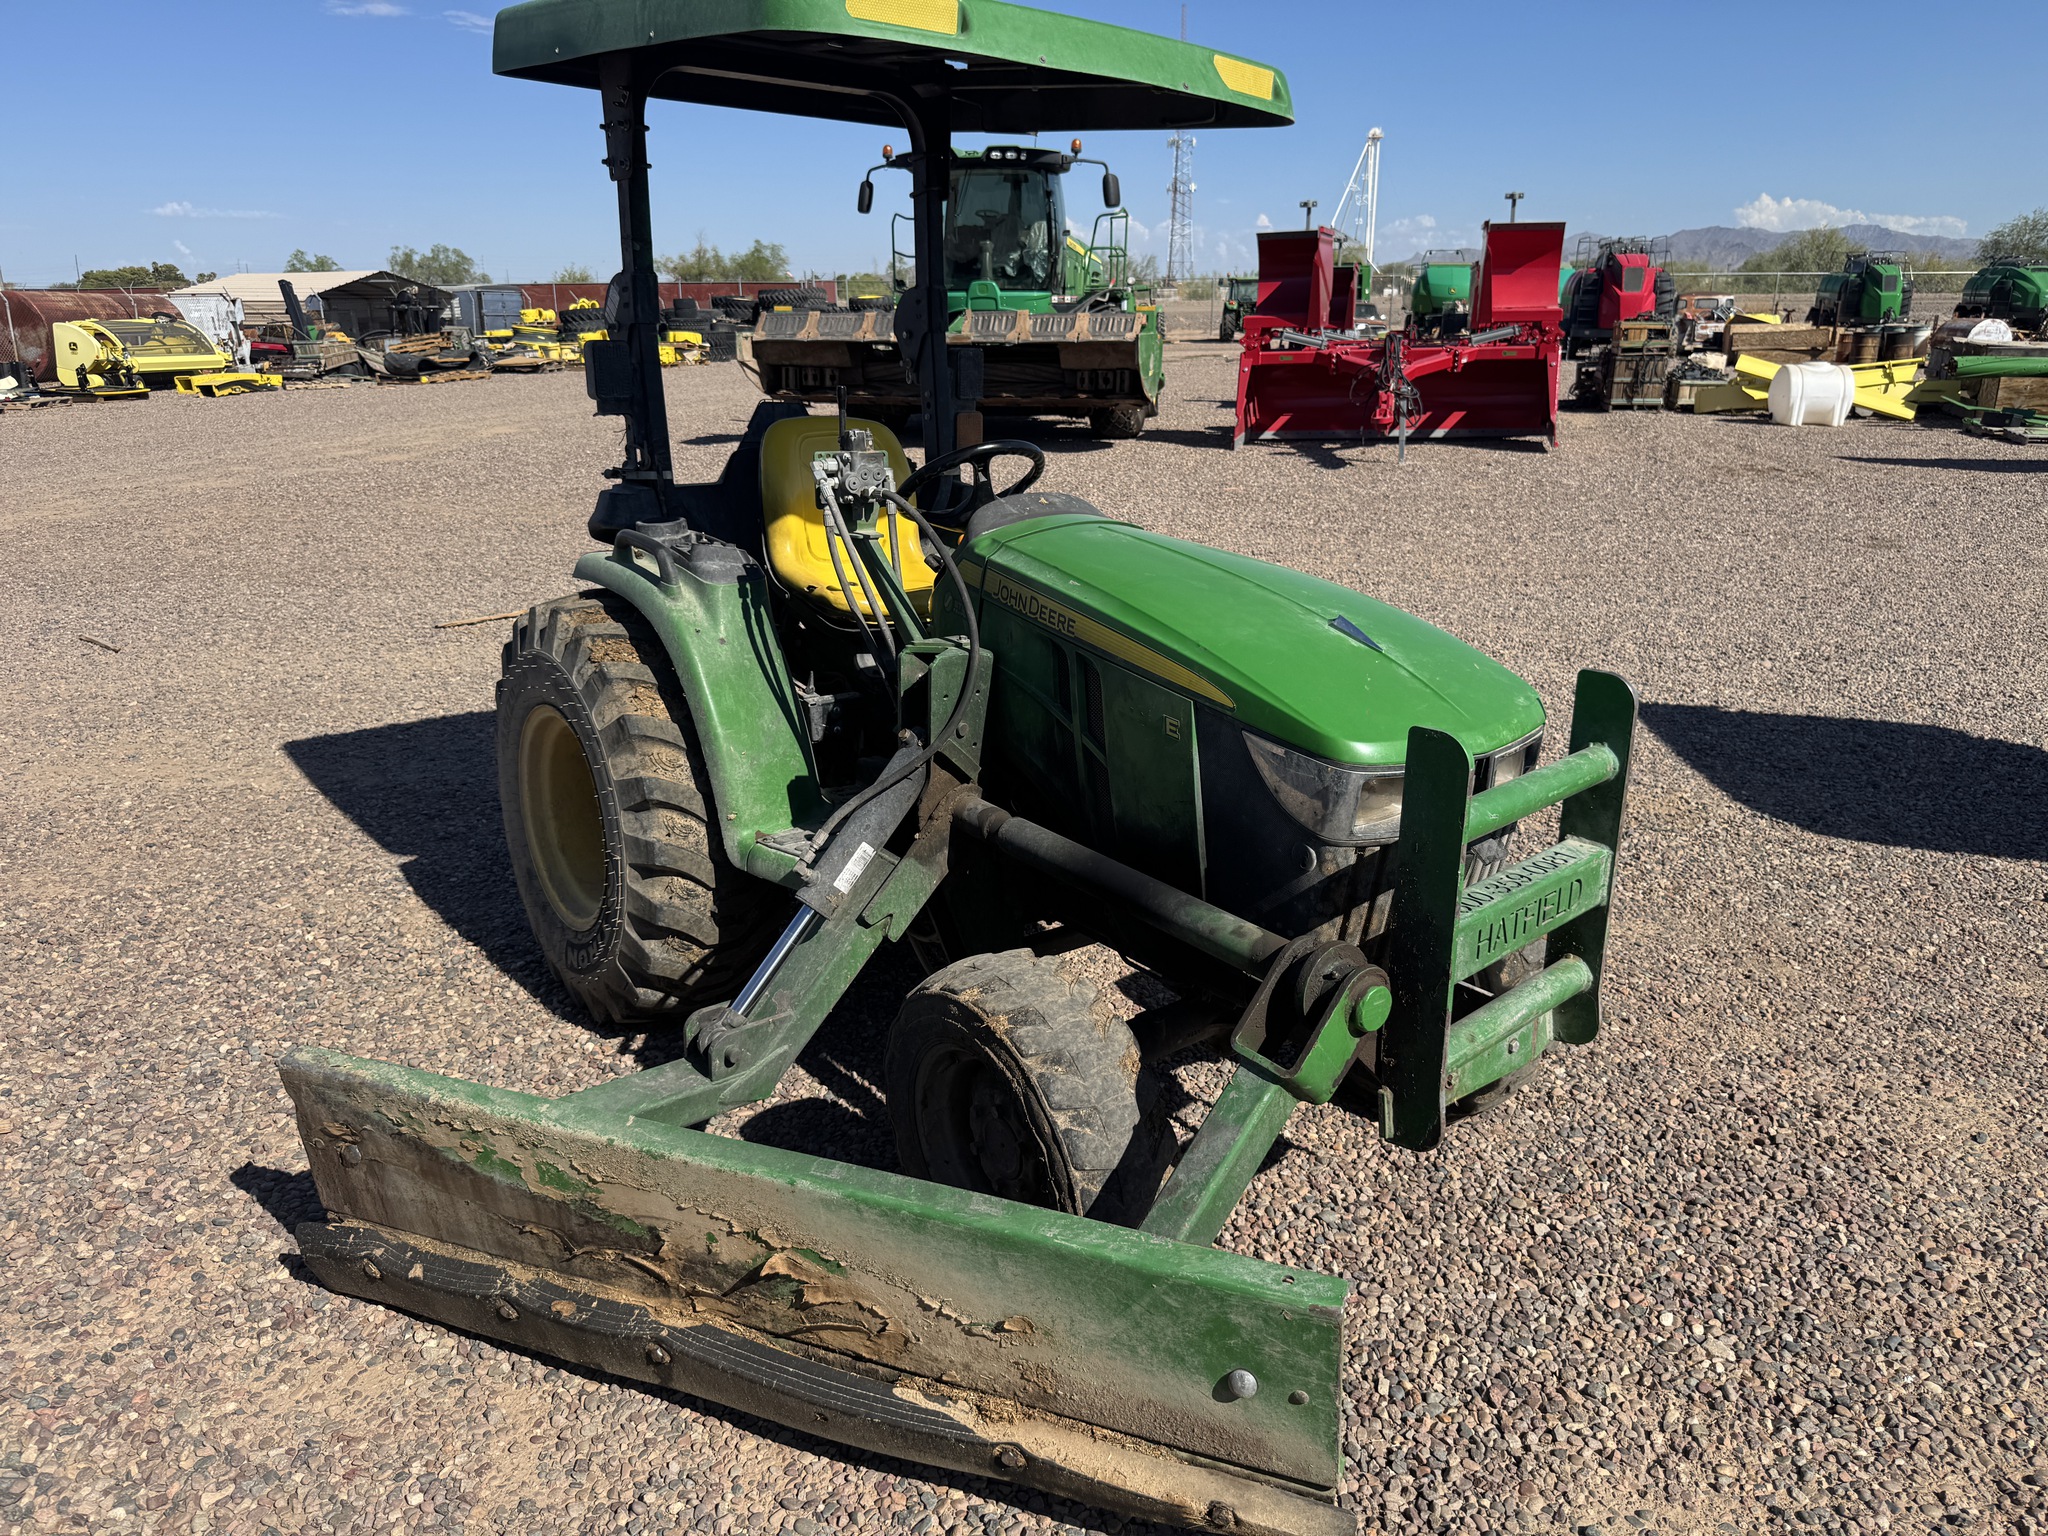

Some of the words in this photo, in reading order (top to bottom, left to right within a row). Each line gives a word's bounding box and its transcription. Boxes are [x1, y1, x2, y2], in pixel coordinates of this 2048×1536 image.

[992, 579, 1028, 612] JOHN
[1028, 595, 1077, 636] DEERE
[1476, 878, 1583, 960] HATFIELD
